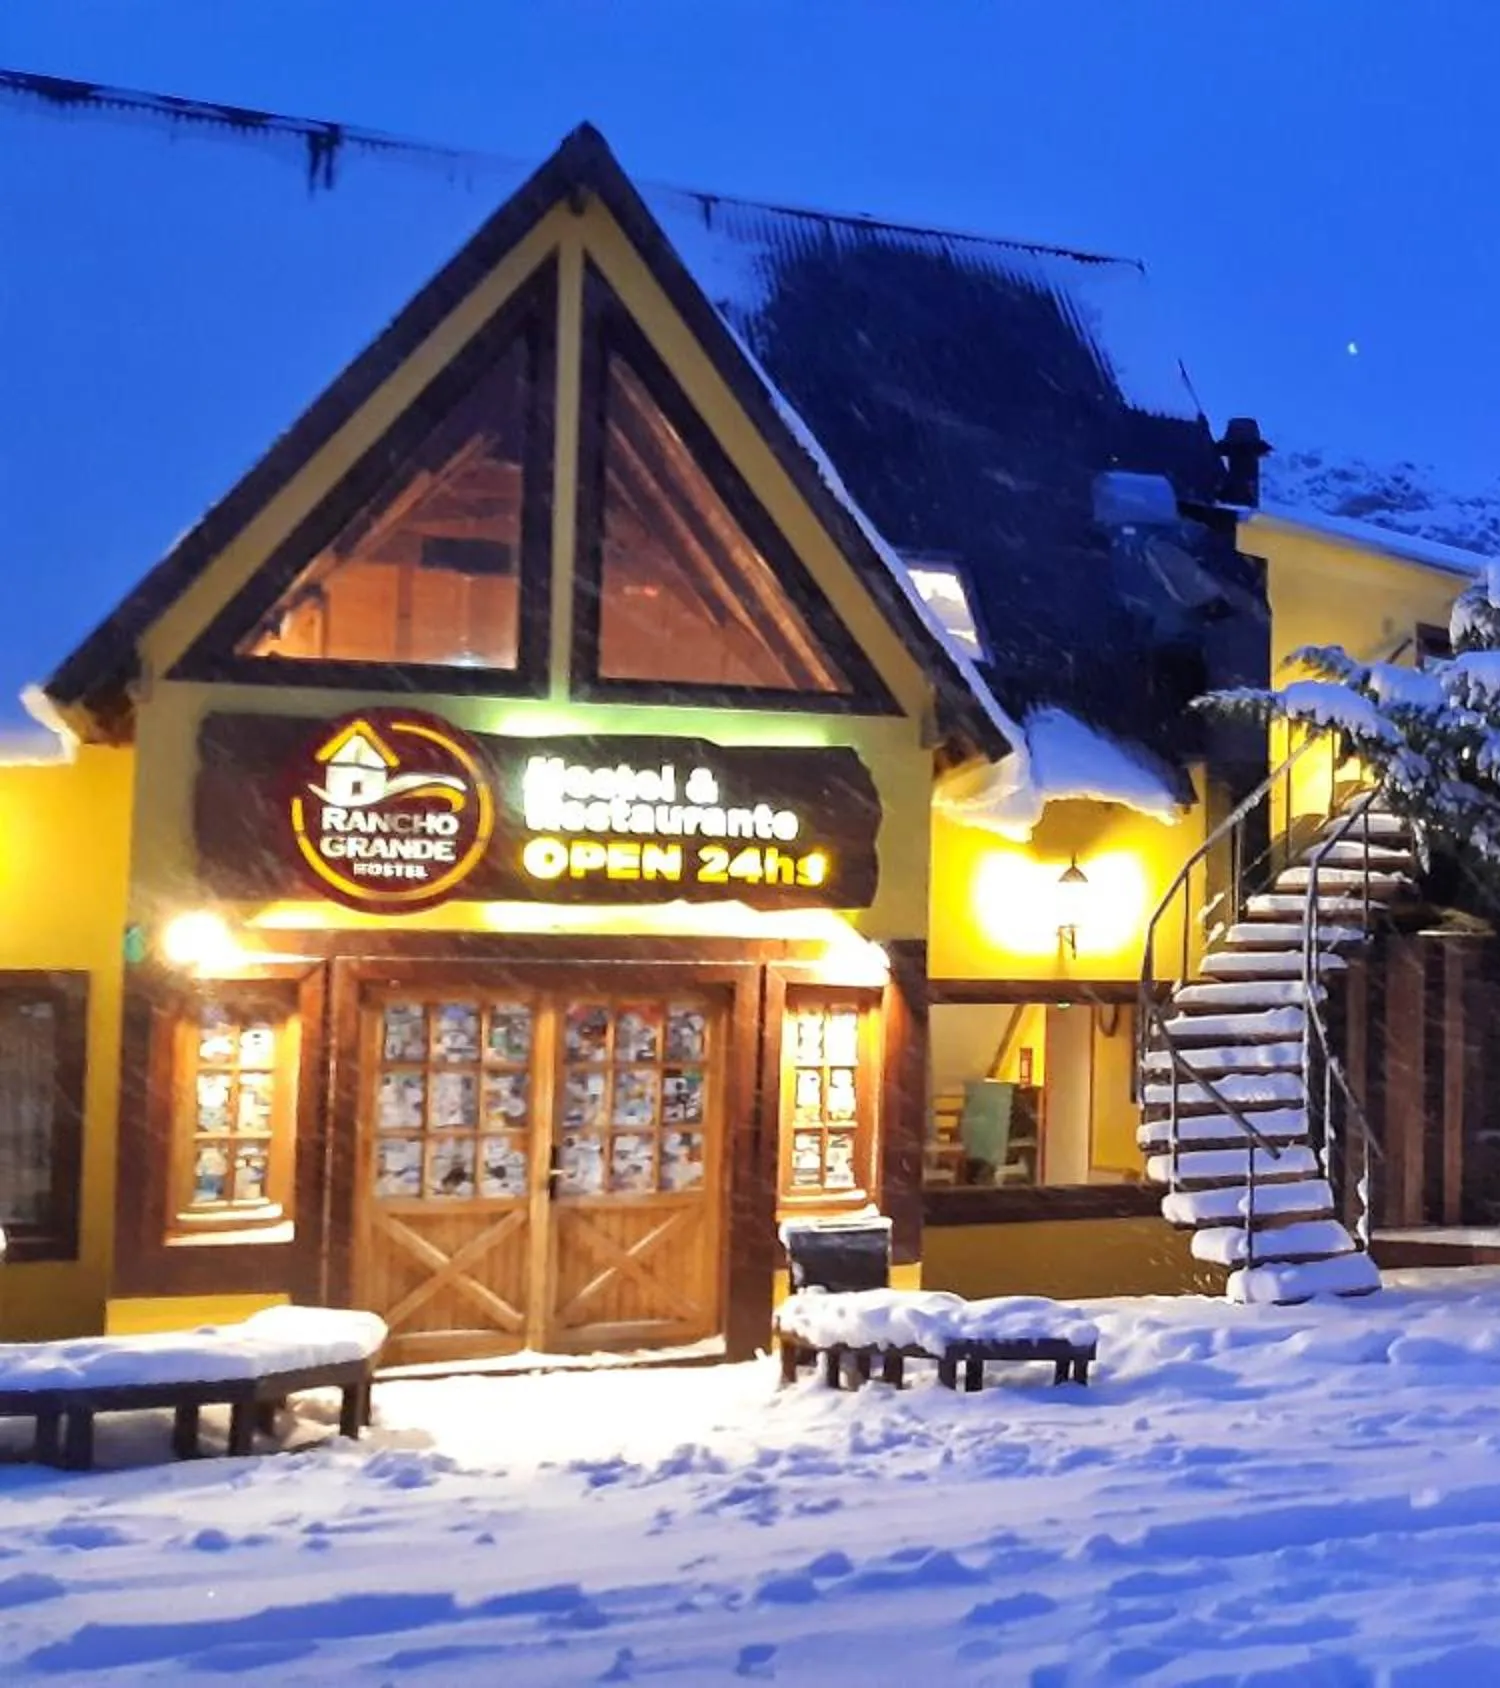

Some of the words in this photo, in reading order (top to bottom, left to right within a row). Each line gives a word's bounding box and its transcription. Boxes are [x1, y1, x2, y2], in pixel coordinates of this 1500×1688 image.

[686, 768, 718, 803] &
[321, 807, 459, 835] RANCHO
[525, 799, 798, 840] Restaurante
[320, 835, 456, 861] GRANDE
[524, 837, 681, 880] OPEN
[698, 844, 827, 886] 24hs
[353, 862, 428, 878] HOSTEL
